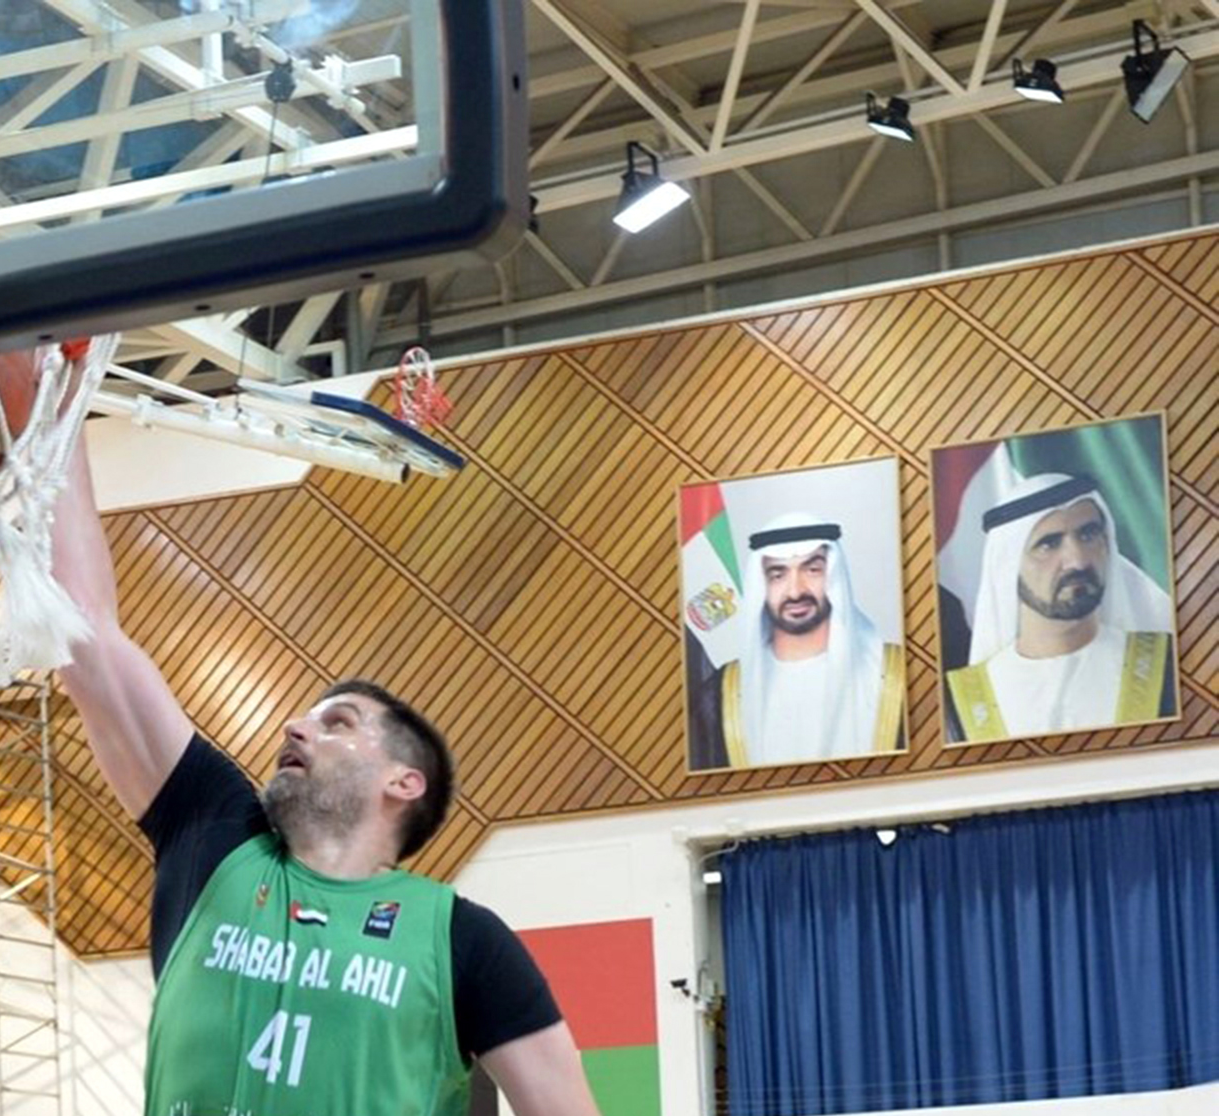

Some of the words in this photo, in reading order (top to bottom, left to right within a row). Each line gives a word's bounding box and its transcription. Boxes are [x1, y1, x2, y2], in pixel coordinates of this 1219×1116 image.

[204, 923, 297, 983] SHABAB
[299, 948, 332, 989] AL
[341, 953, 407, 1009] AHLI
[247, 1009, 312, 1087] 41
